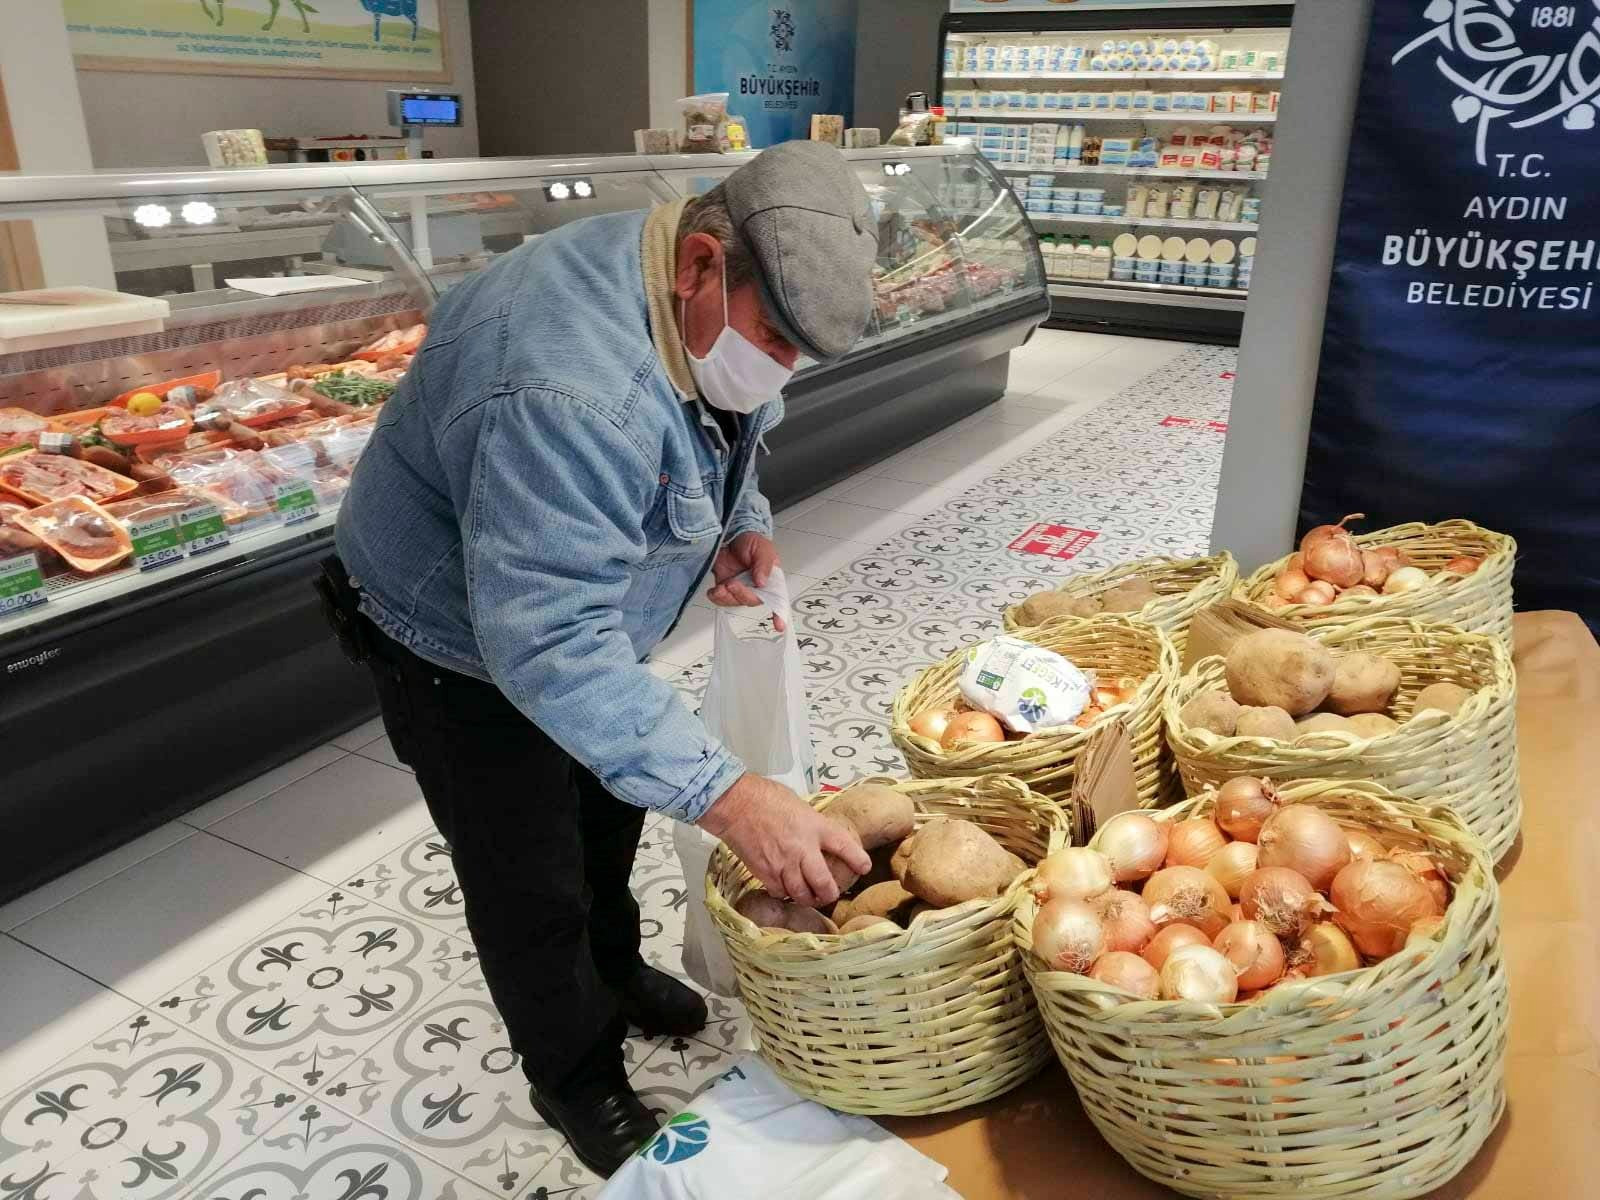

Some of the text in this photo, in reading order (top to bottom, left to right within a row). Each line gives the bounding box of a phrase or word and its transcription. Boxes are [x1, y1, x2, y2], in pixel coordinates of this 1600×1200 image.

[1531, 6, 1575, 28] 1881
[740, 74, 821, 99] BÜYÜKŞEHİR
[1496, 153, 1551, 178] T.C.
[1463, 196, 1568, 220] AYDIN
[1407, 282, 1593, 309] BELEDİYESİ
